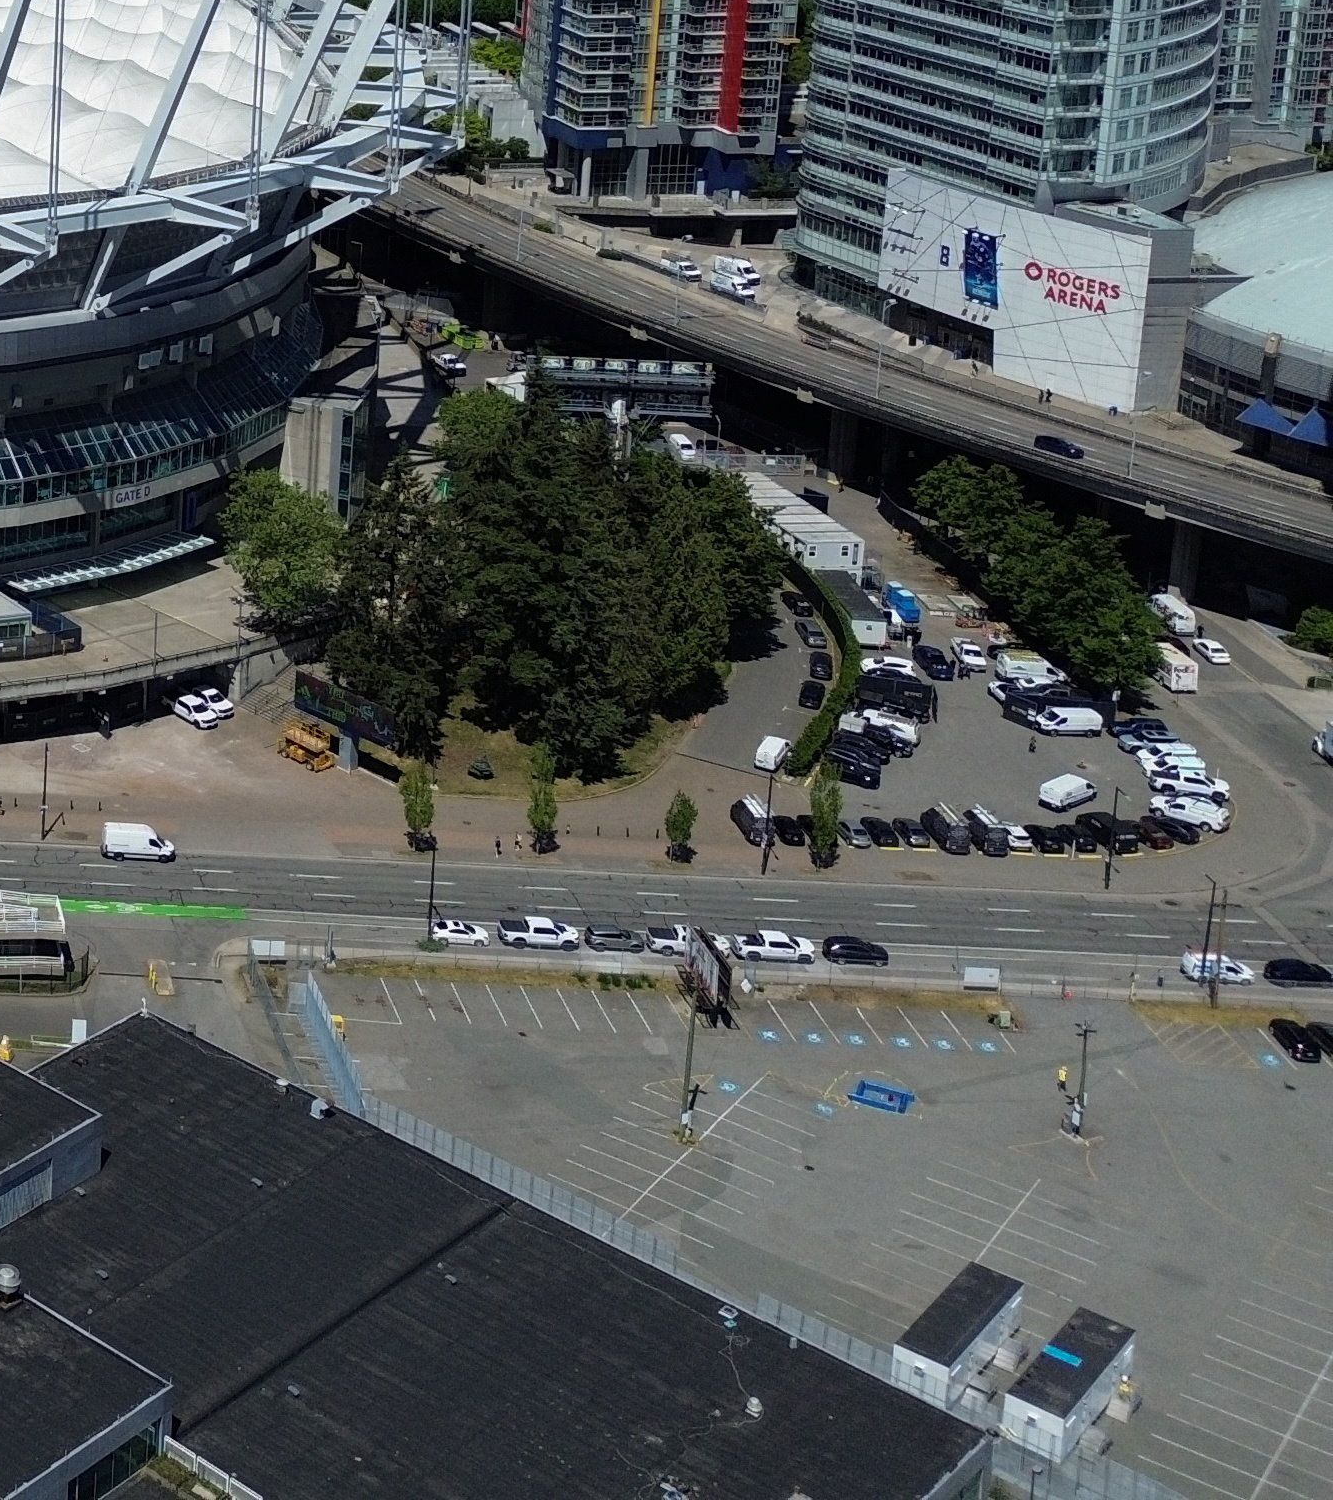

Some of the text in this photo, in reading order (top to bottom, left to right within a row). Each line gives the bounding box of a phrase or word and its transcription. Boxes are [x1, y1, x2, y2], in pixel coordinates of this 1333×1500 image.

[1046, 268, 1121, 300] ROGERS
[1044, 285, 1107, 315] ARENA
[116, 485, 151, 504] GATE D
